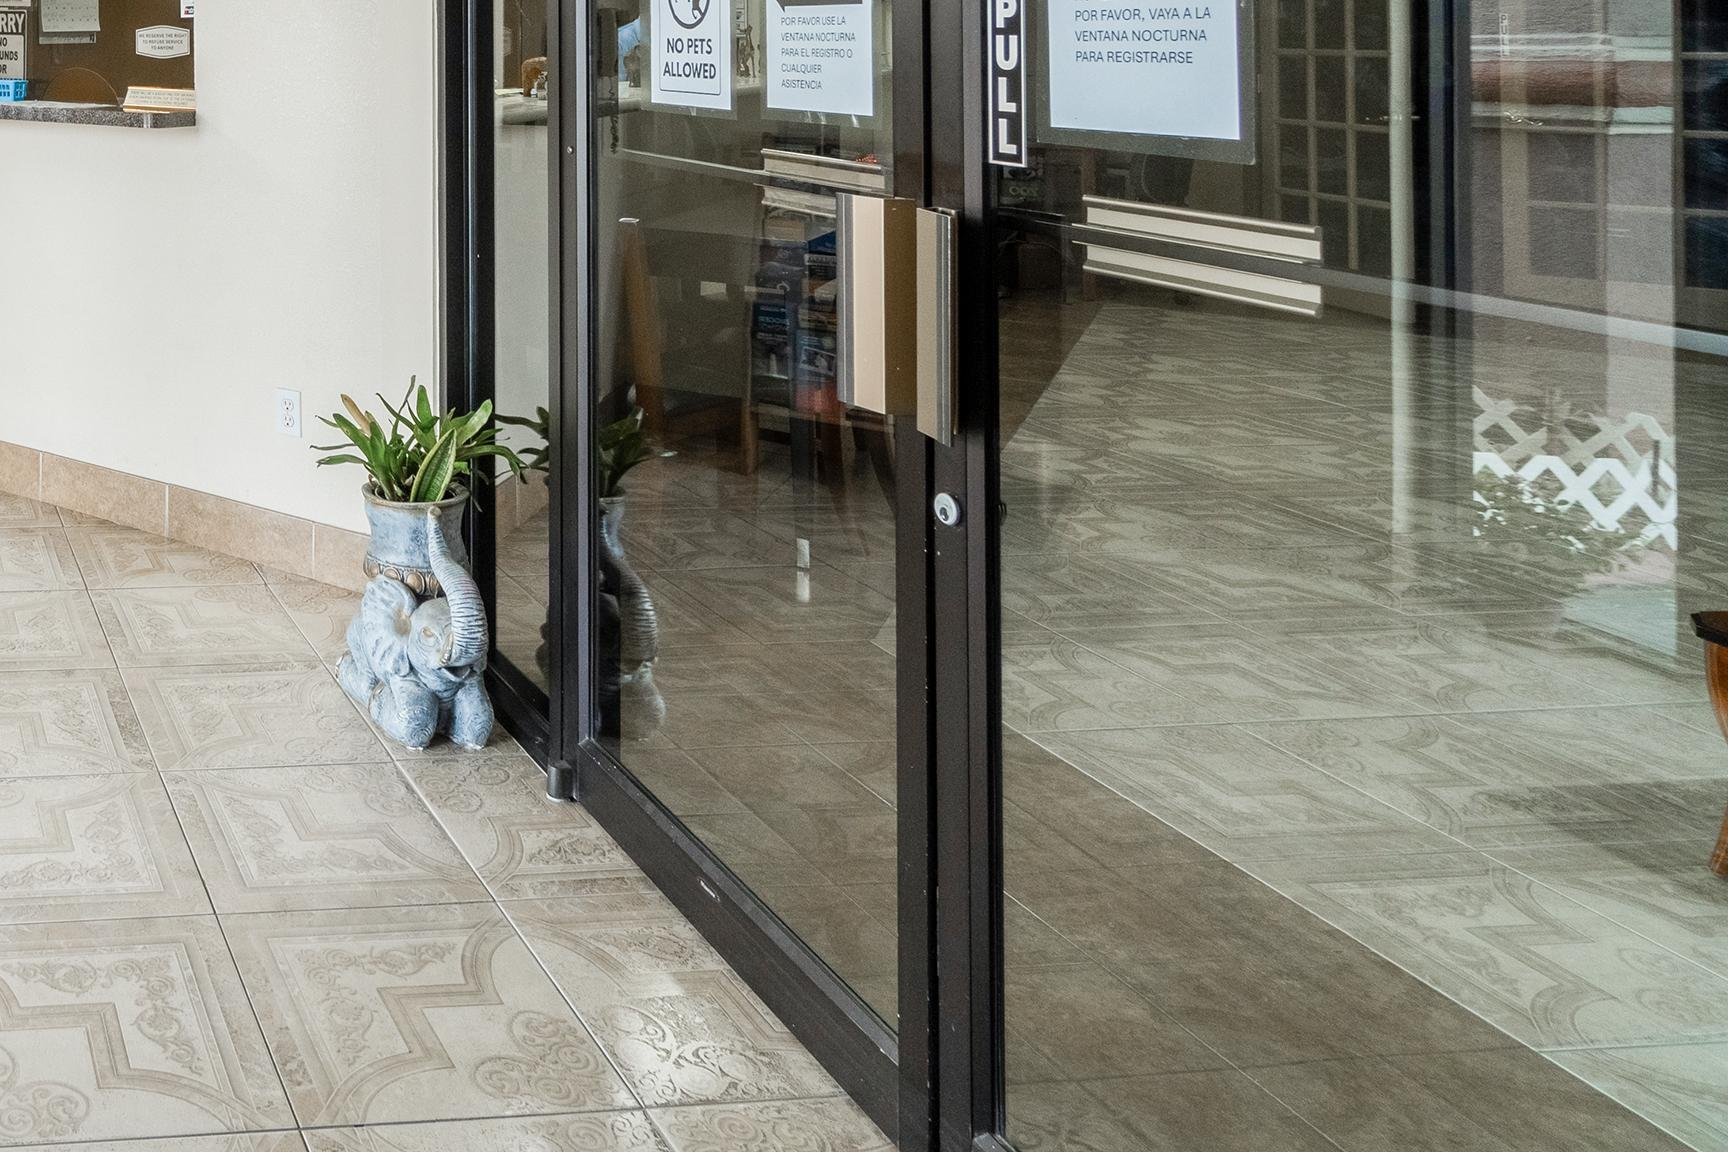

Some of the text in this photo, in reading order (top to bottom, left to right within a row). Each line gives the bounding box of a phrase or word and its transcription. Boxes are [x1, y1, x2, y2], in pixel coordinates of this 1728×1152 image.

[1075, 6, 1211, 22] POR FAVOR, VAYA A LA
[781, 16, 846, 26] POR FAVOR USE LA
[781, 32, 855, 42] VENTANA NOCTURNA
[1075, 29, 1206, 42] VENTANA NOCTURNA
[666, 38, 712, 54] NO PETS
[781, 48, 852, 58] PARA EL REGISTRO O
[1076, 51, 1192, 63] PARA REGISTRARSE
[663, 62, 716, 79] ALLOWED
[781, 63, 822, 74] CUALQUIER
[781, 79, 822, 90] ASISTENCIA
